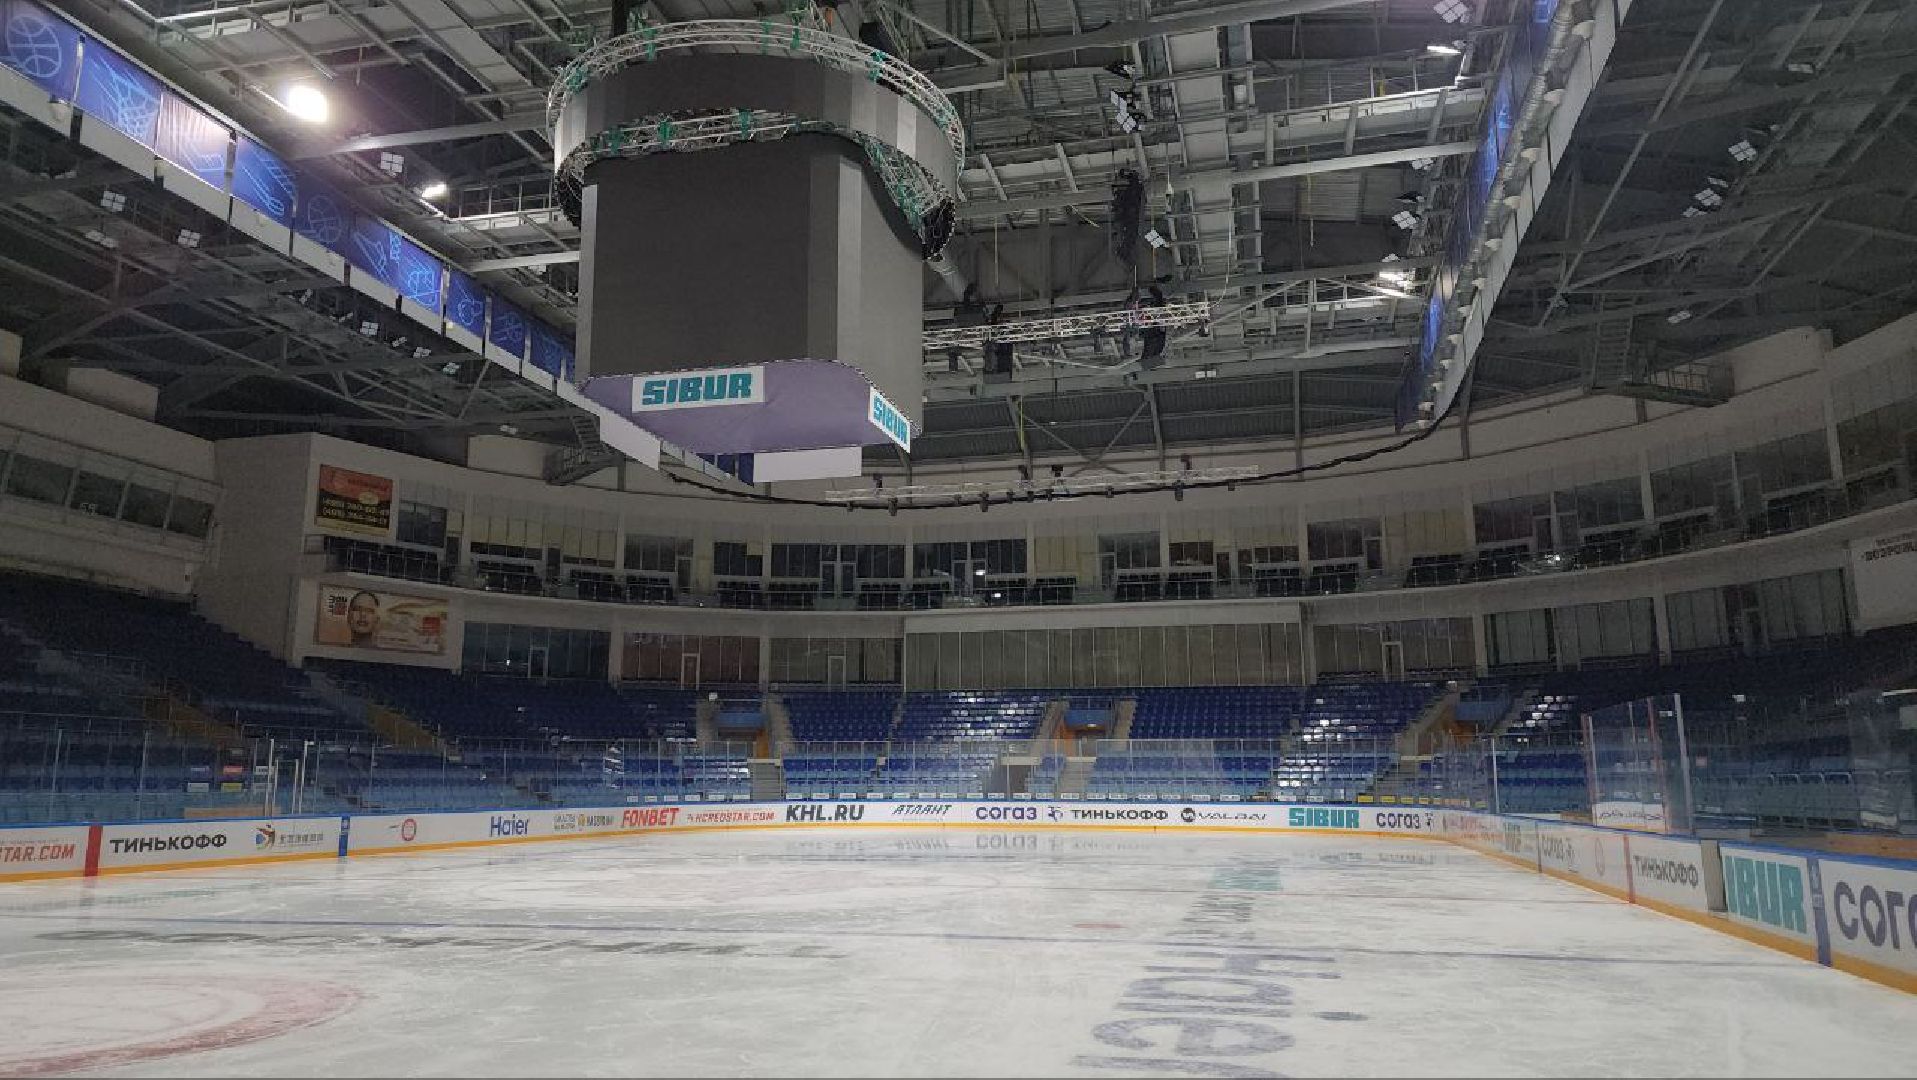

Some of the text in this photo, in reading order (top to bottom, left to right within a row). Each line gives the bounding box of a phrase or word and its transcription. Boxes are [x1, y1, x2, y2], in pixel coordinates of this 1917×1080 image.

[643, 373, 751, 405] SIBUR
[873, 397, 908, 445] SIBUR
[621, 807, 680, 829] FONBET
[786, 804, 865, 821] KHL.RU
[1072, 808, 1169, 821] ТИНЬКОФФ
[1289, 807, 1360, 829] SIBUR
[490, 813, 530, 838] Haier
[0, 844, 76, 862] TAR.COM
[109, 833, 228, 854] ТИНЬКОФФ
[1632, 854, 1699, 889] ТИНЬКОФФ
[1725, 855, 1807, 934] IBUR
